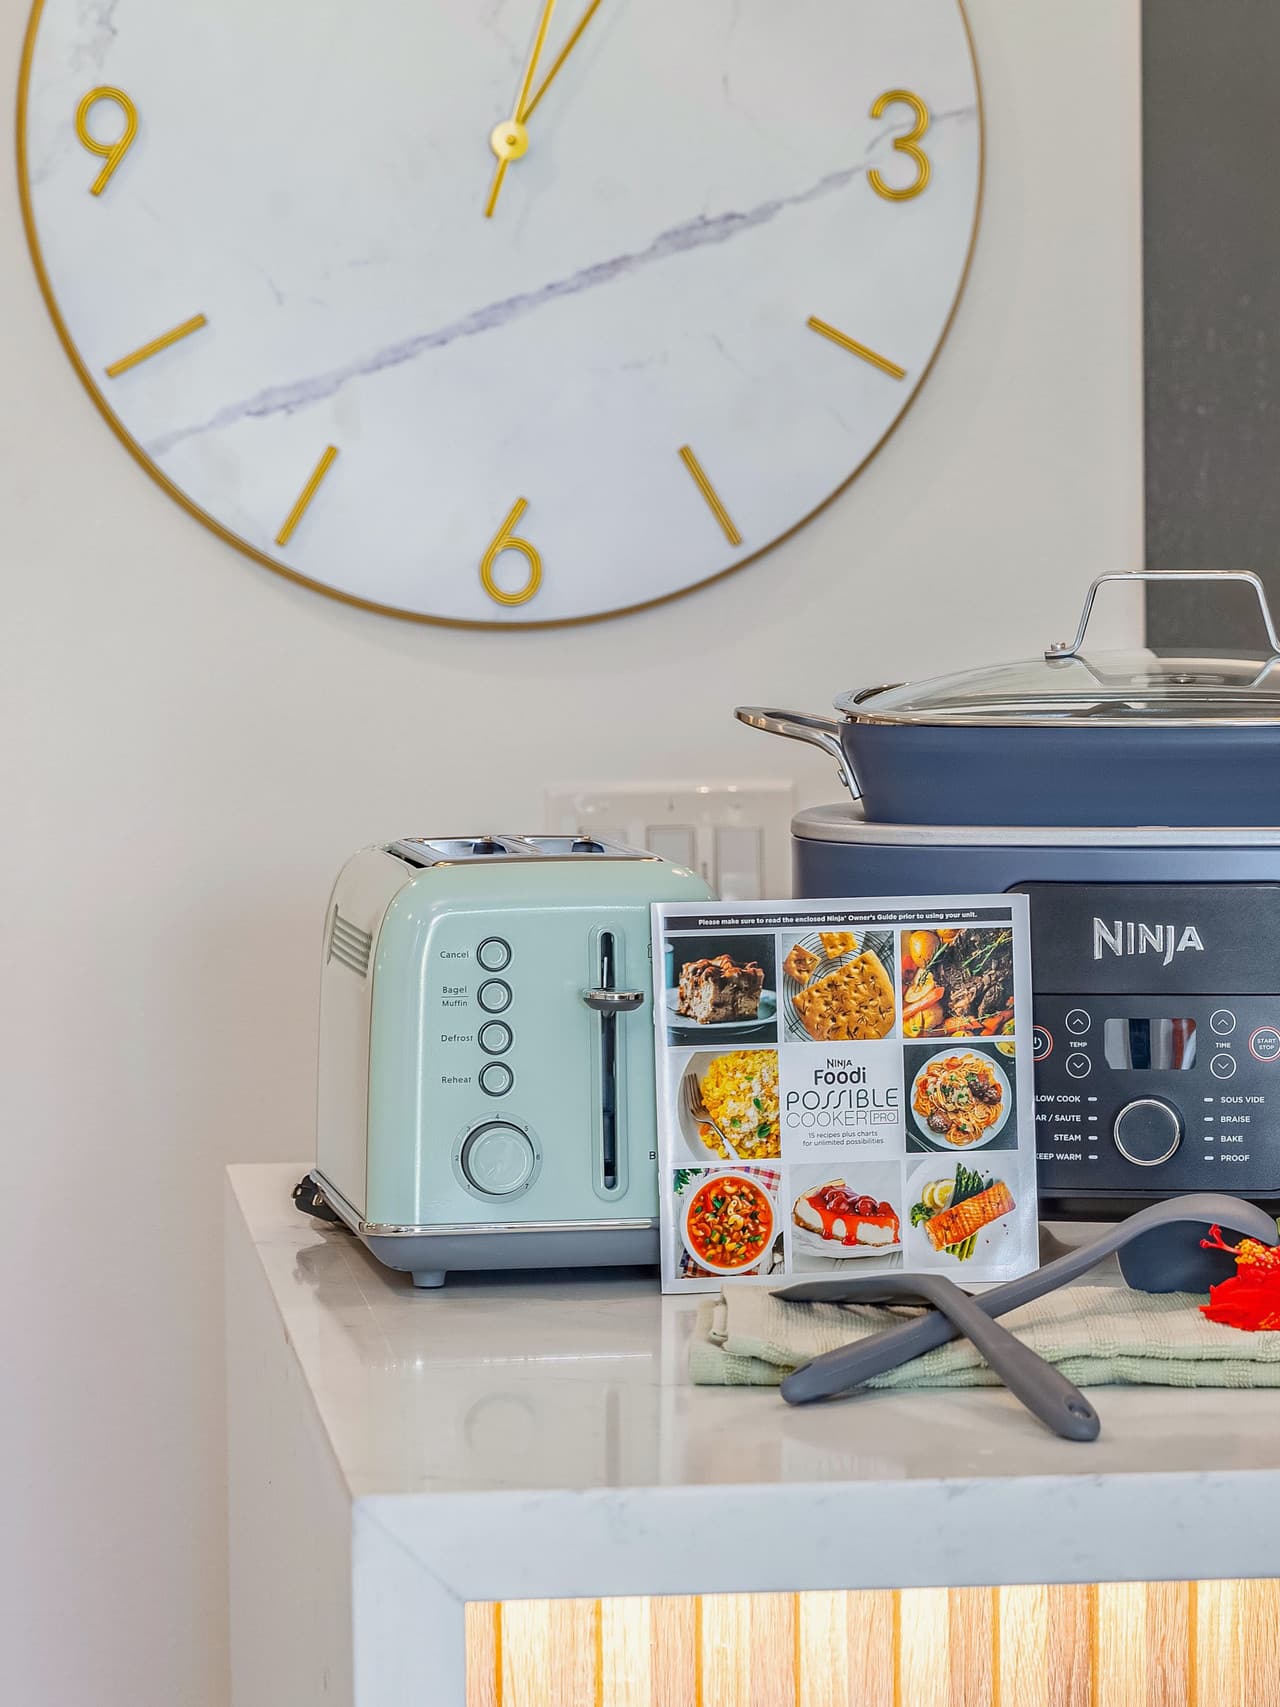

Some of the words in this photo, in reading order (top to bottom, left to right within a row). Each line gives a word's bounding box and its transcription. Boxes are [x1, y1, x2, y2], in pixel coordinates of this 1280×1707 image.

[75, 86, 137, 195] 9
[868, 90, 930, 202] 3
[480, 497, 542, 606] 6
[877, 913, 898, 921] Guide
[898, 913, 916, 921] prior
[925, 912, 944, 920] using
[945, 912, 961, 920] your
[1093, 917, 1205, 966] NINJA
[440, 950, 469, 959] Cancel
[442, 986, 467, 995] Bagel
[441, 1034, 473, 1042] Defrost
[826, 1058, 853, 1069] NINJA
[814, 1066, 866, 1085] Foodi
[441, 1076, 471, 1084] Reheat
[786, 1088, 899, 1111] POSSIBLE
[1056, 1095, 1081, 1103] COOK
[1220, 1096, 1244, 1104] SOUS
[1245, 1096, 1265, 1104] VIDE
[786, 1110, 868, 1128] COOKER
[873, 1112, 896, 1122] PRO
[1036, 1114, 1047, 1122] AR
[1054, 1114, 1081, 1122] SAUTE
[1220, 1115, 1251, 1123] BRAISE
[816, 1131, 840, 1139] recipes
[1054, 1134, 1082, 1142] STEAM
[1220, 1135, 1244, 1143] BAKE
[846, 1138, 884, 1146] possibilities
[1055, 1153, 1082, 1161] WARM
[1220, 1154, 1250, 1162] PROOF
